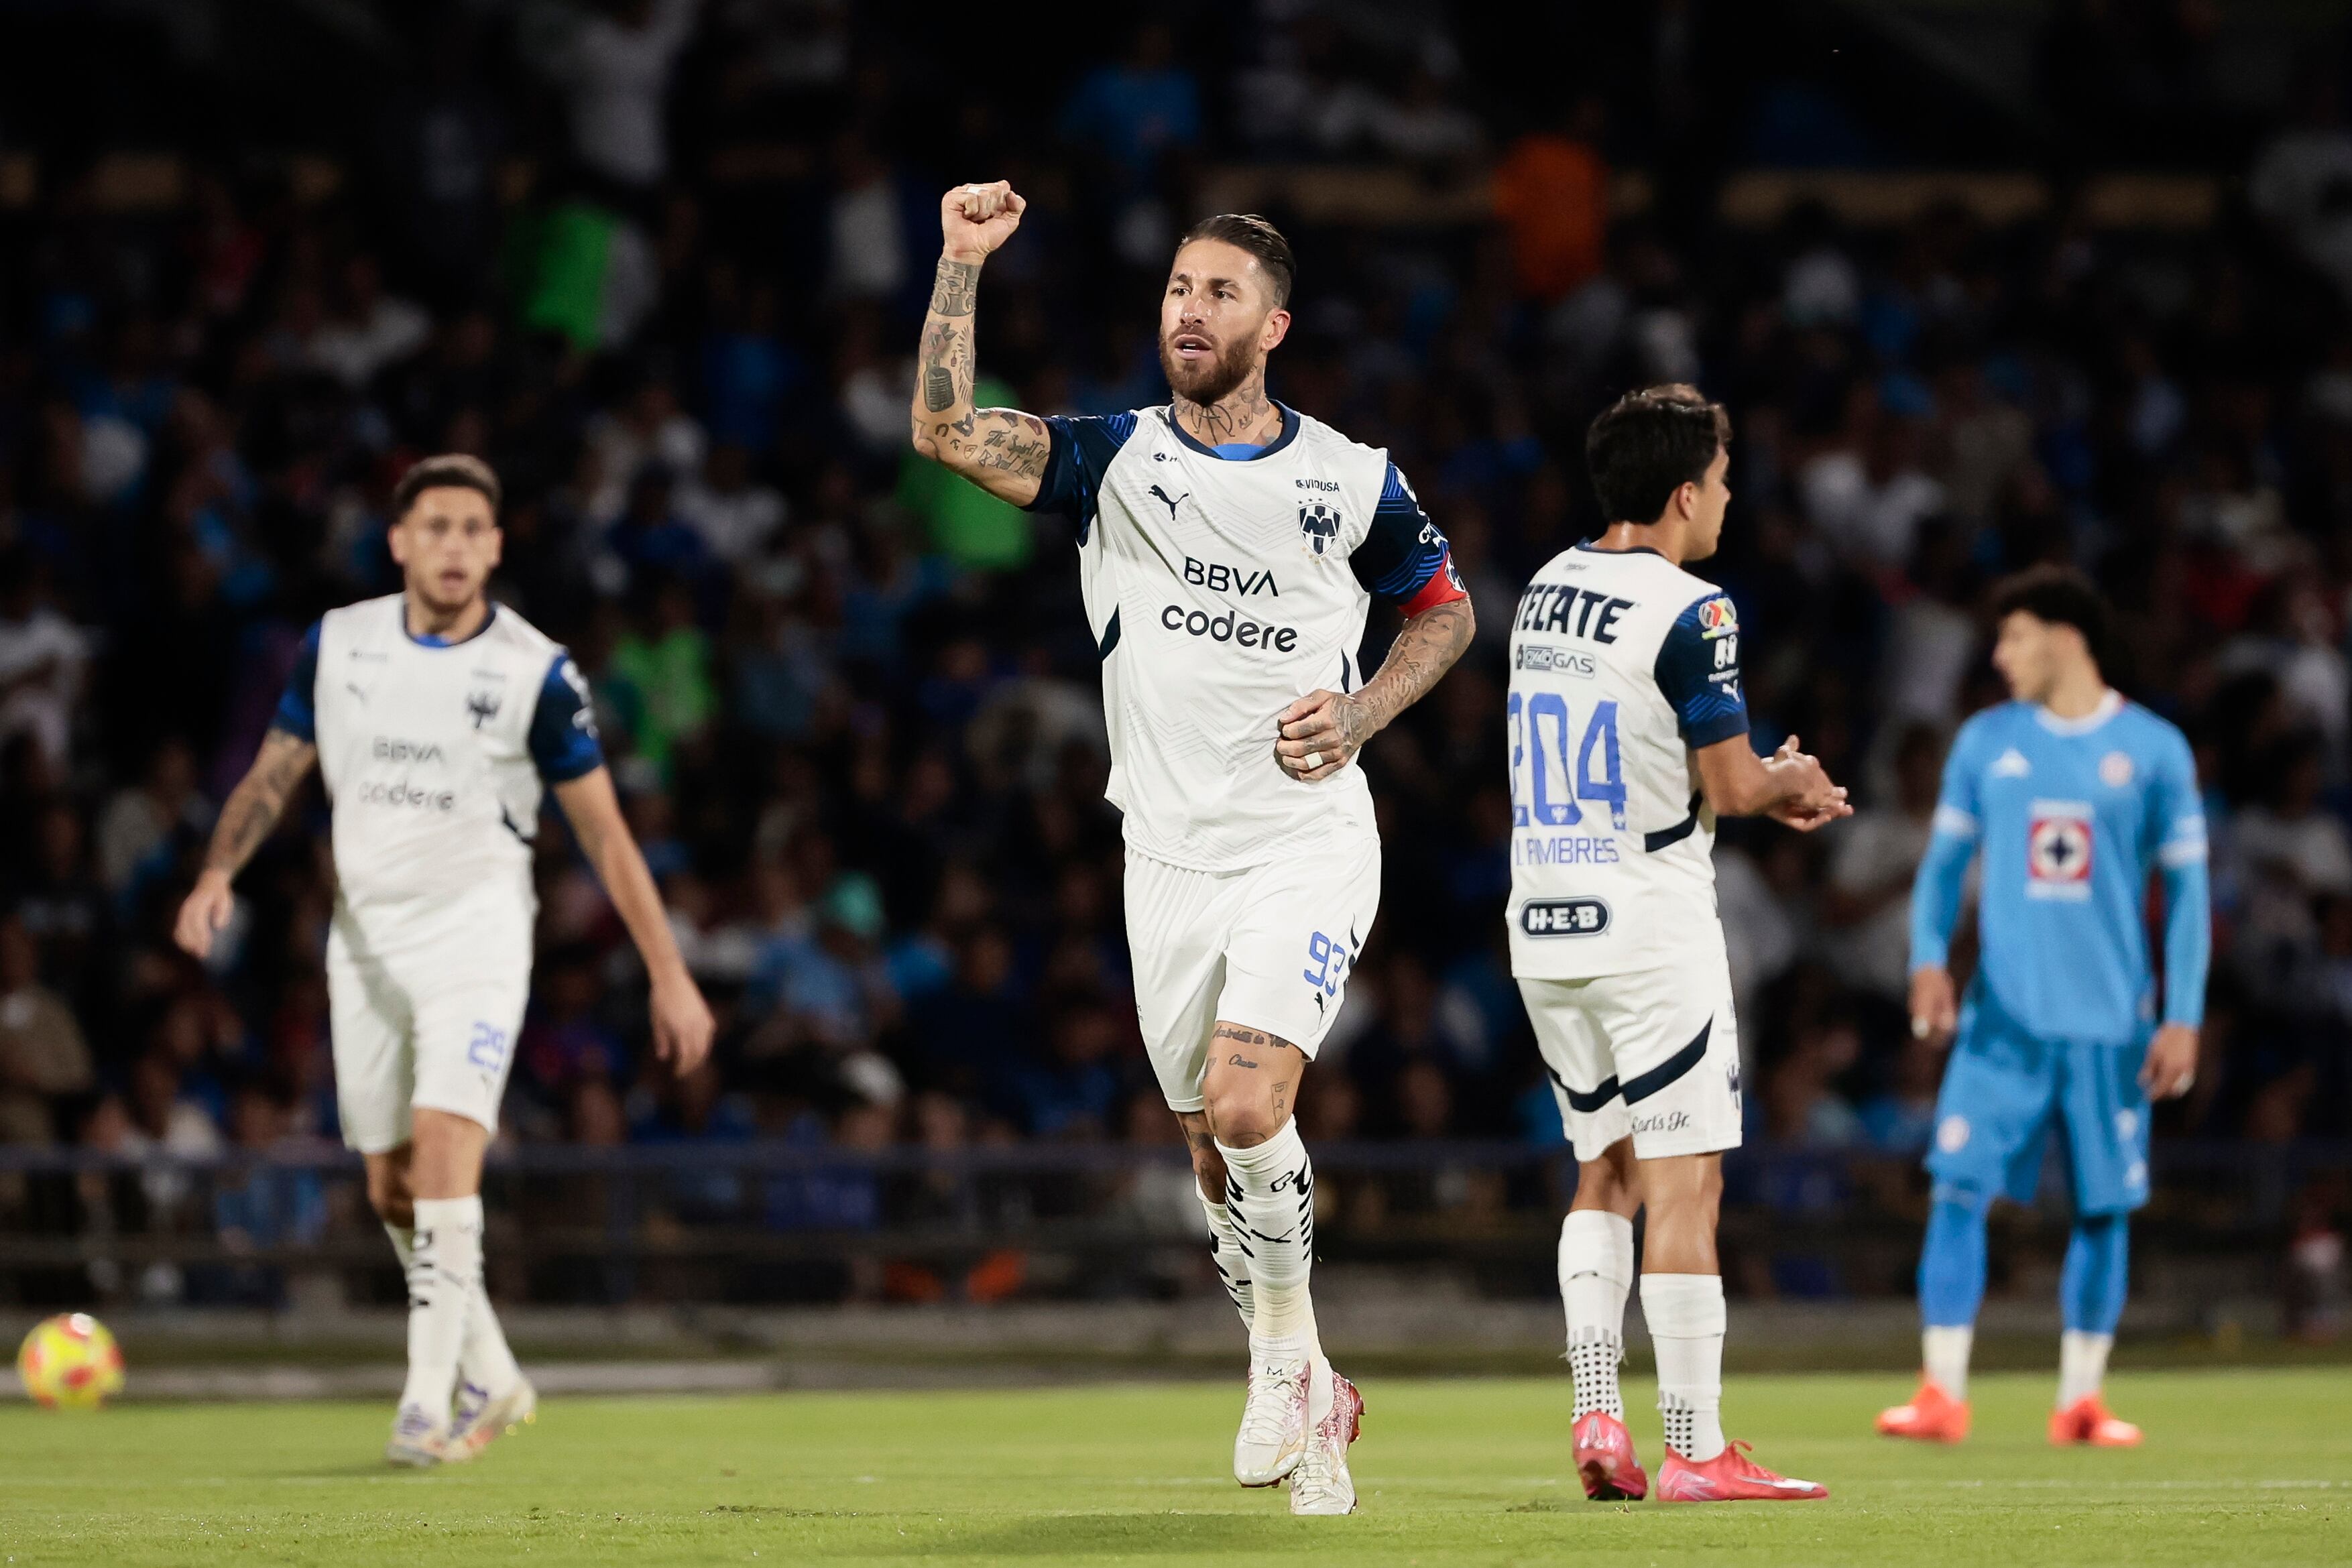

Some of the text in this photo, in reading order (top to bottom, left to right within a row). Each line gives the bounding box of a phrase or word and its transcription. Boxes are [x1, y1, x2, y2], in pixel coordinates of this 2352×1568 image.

[1184, 556, 1279, 597] BBVA
[1161, 605, 1297, 652] codere
[1515, 584, 1635, 644] TECATE
[1553, 653, 1594, 672] GAS
[1508, 692, 1626, 830] 204
[1303, 931, 1346, 997] 93
